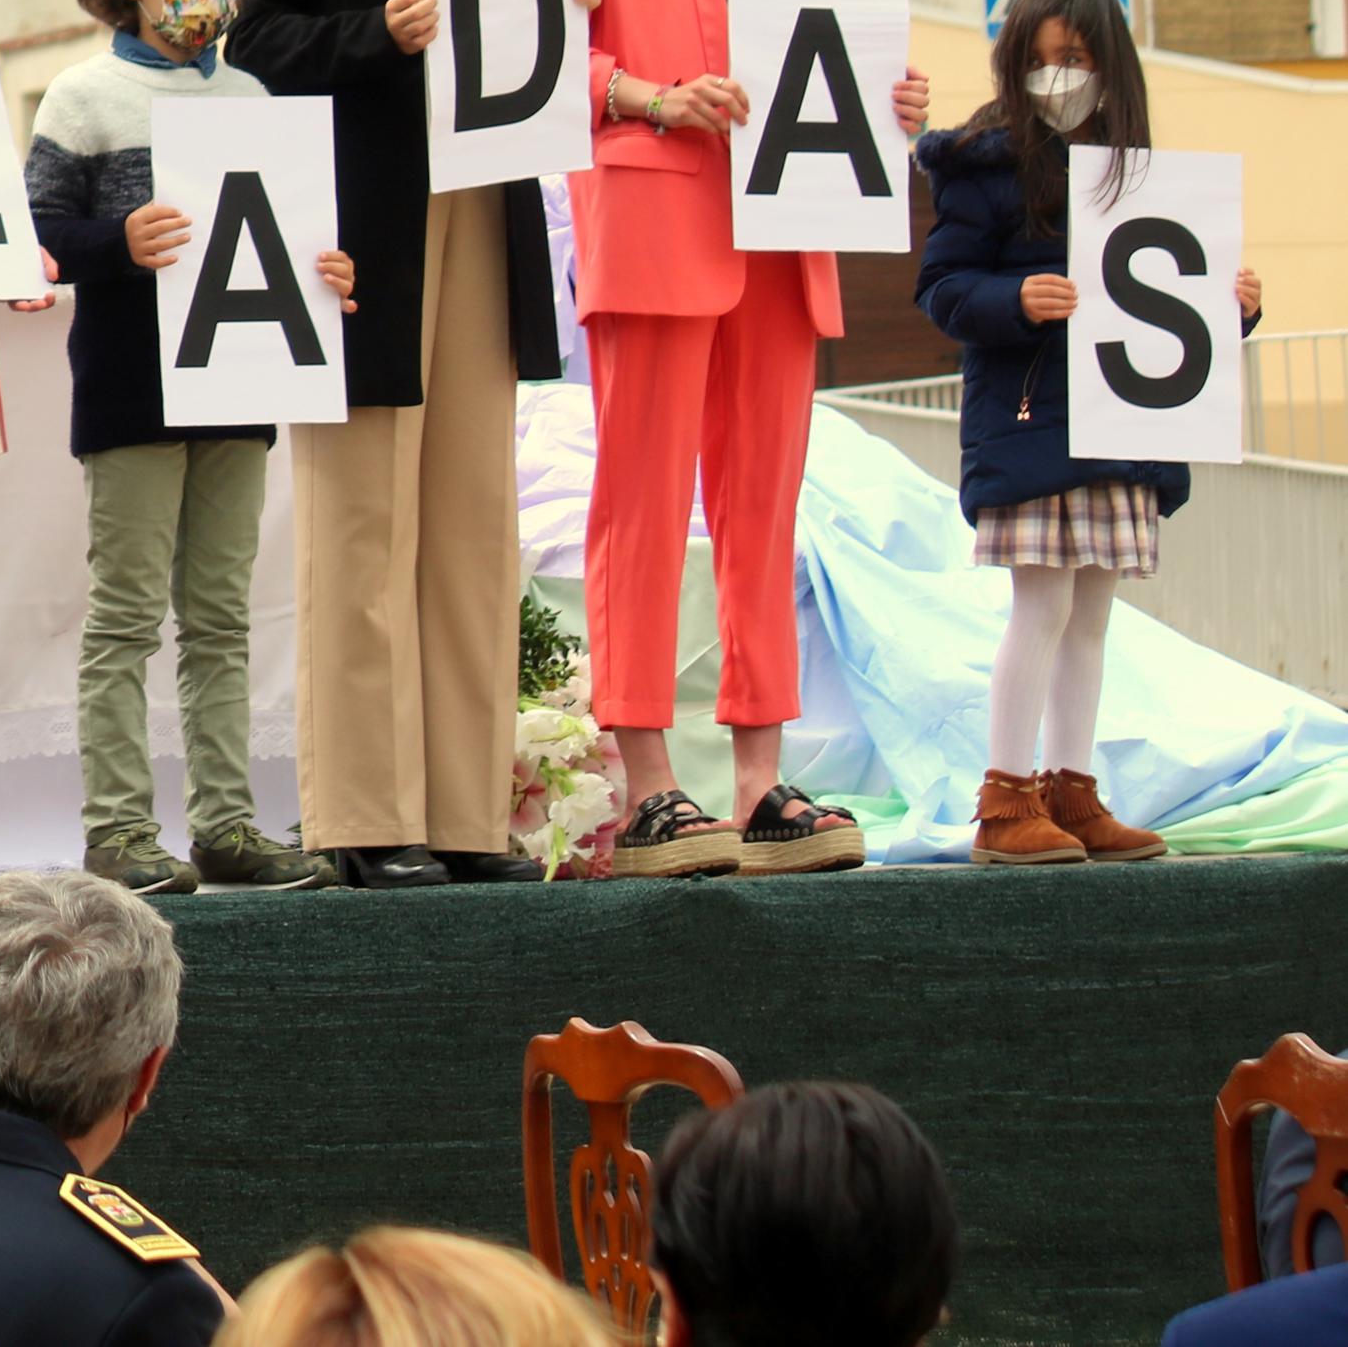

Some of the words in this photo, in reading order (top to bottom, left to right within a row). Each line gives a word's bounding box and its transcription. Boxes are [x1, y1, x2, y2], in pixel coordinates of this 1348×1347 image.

[745, 8, 893, 197] A
[174, 171, 327, 369] A
[1095, 217, 1212, 410] S
